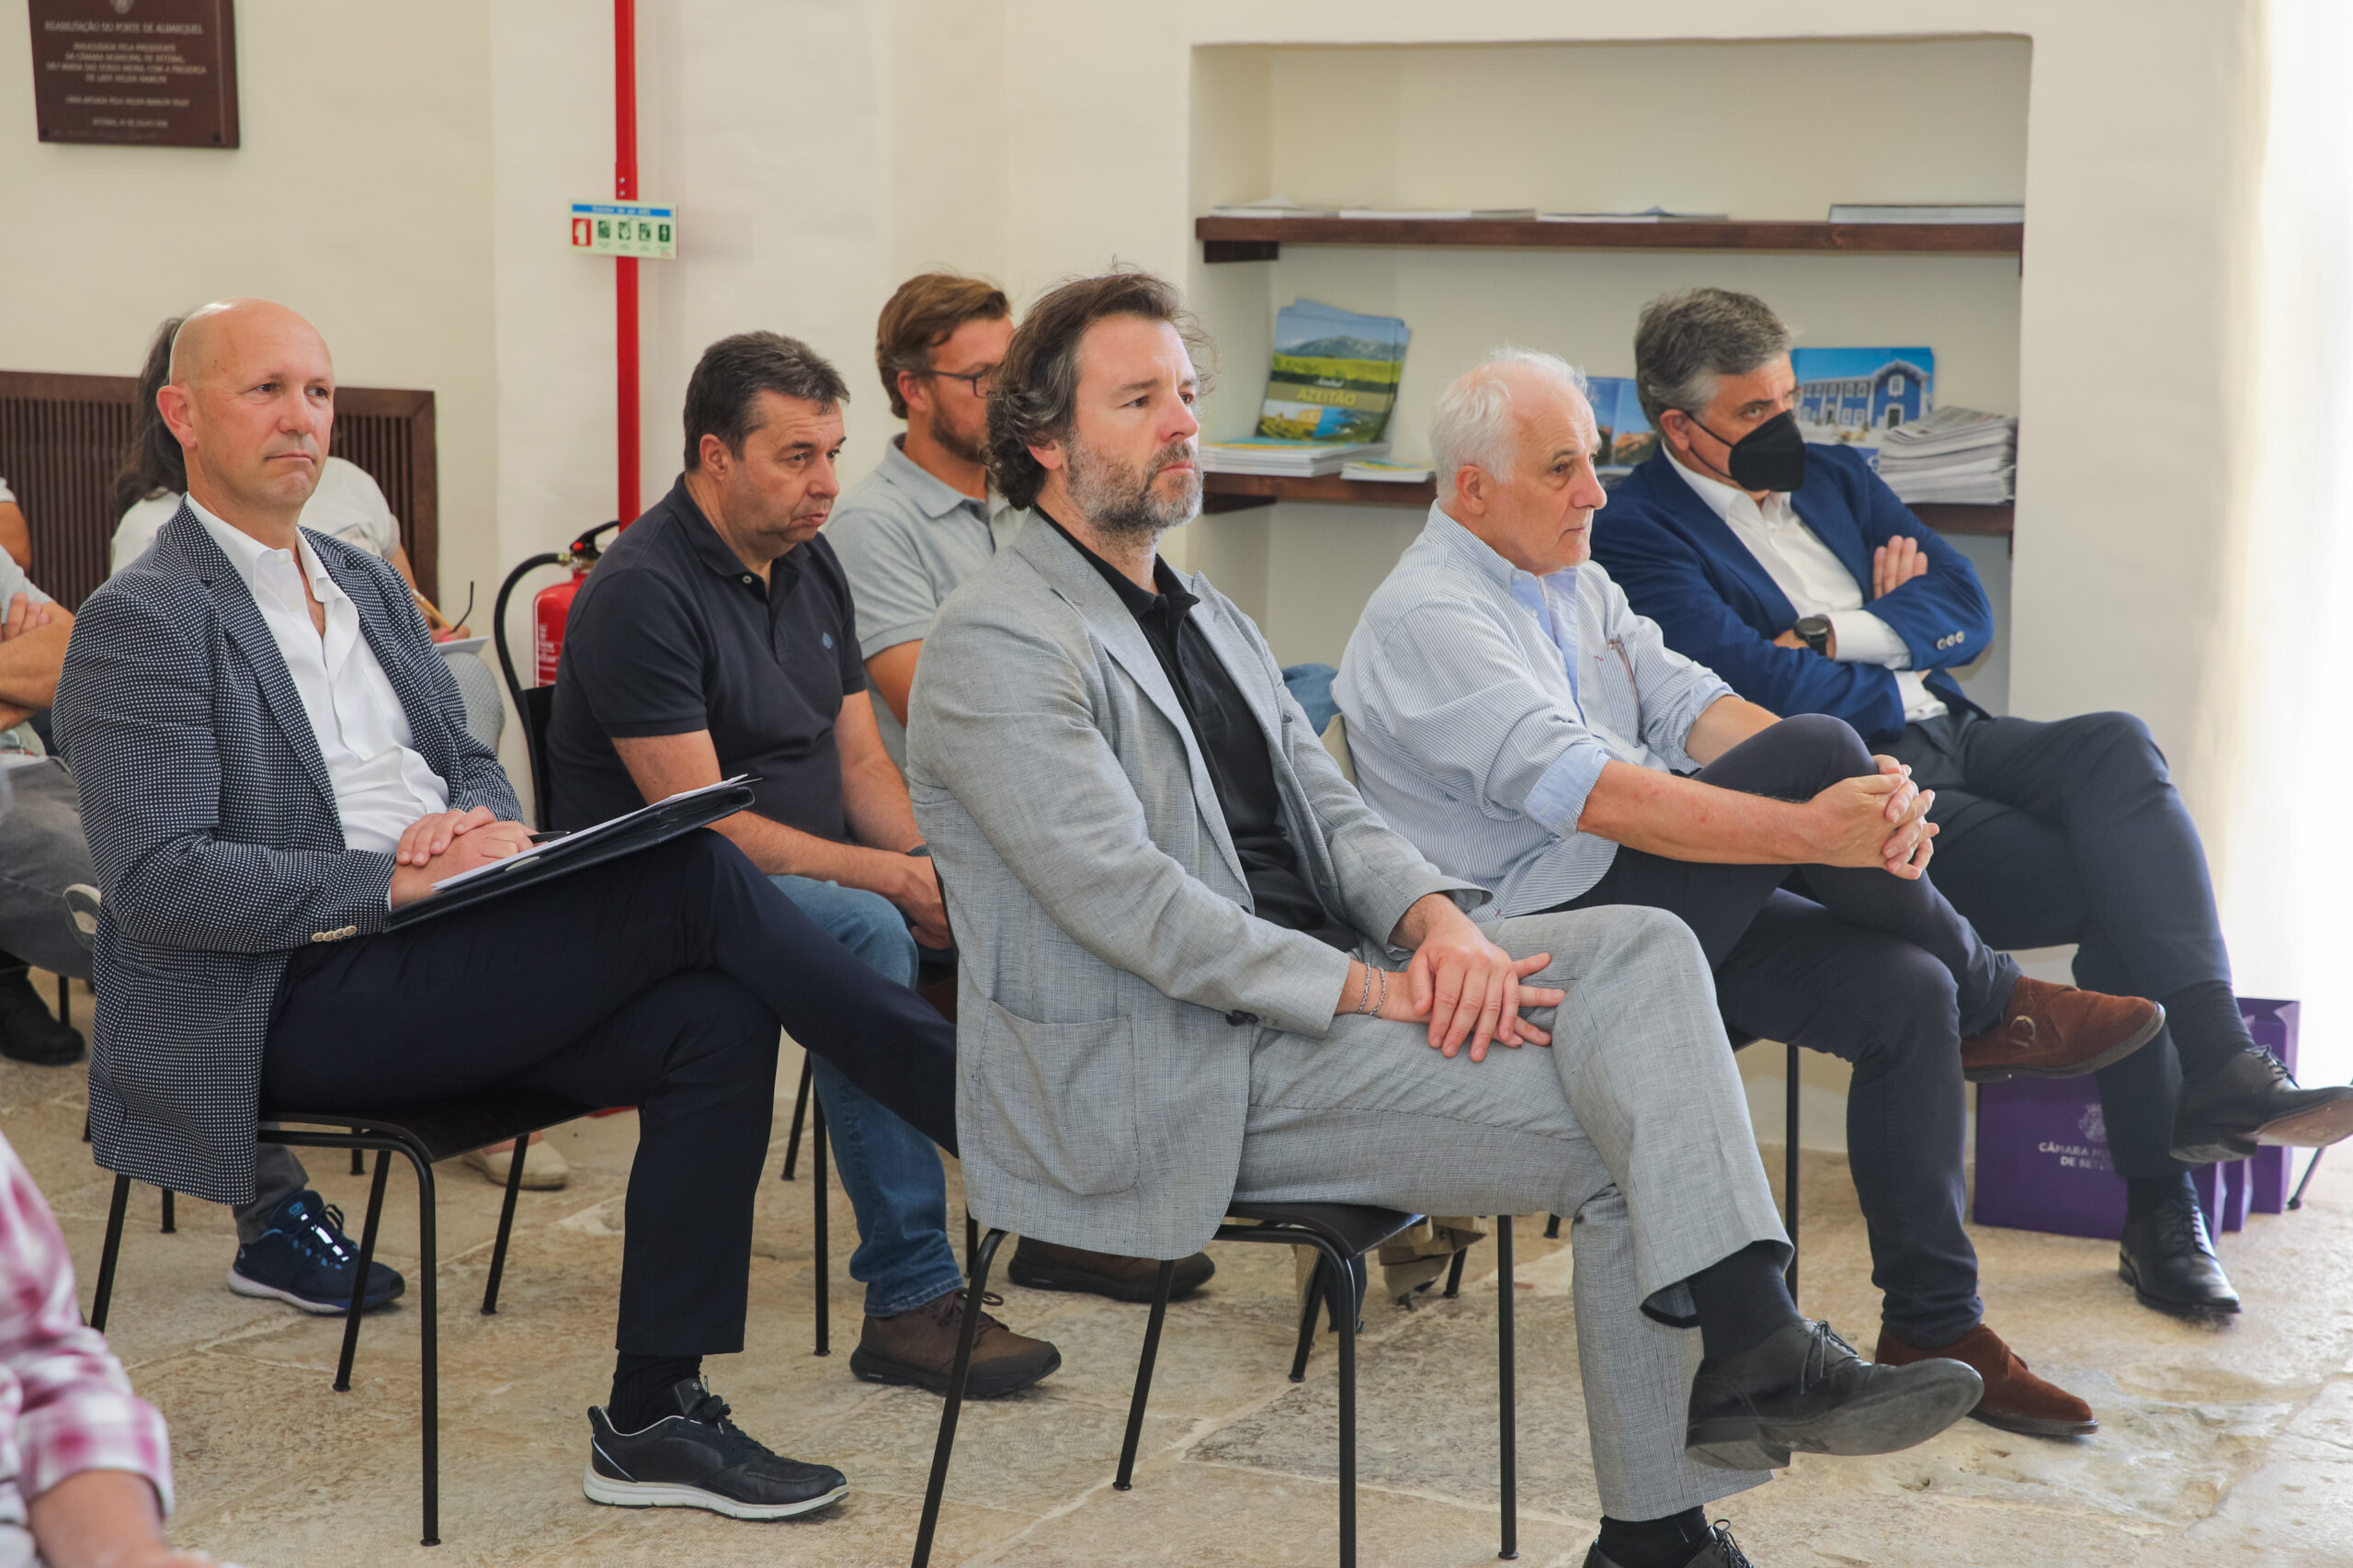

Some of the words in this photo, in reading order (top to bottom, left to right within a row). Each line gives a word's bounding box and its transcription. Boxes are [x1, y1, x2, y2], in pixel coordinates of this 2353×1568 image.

[1297, 387, 1357, 406] AZEITÃO
[2039, 1142, 2088, 1156] CÂMARA
[2060, 1155, 2077, 1168] DE
